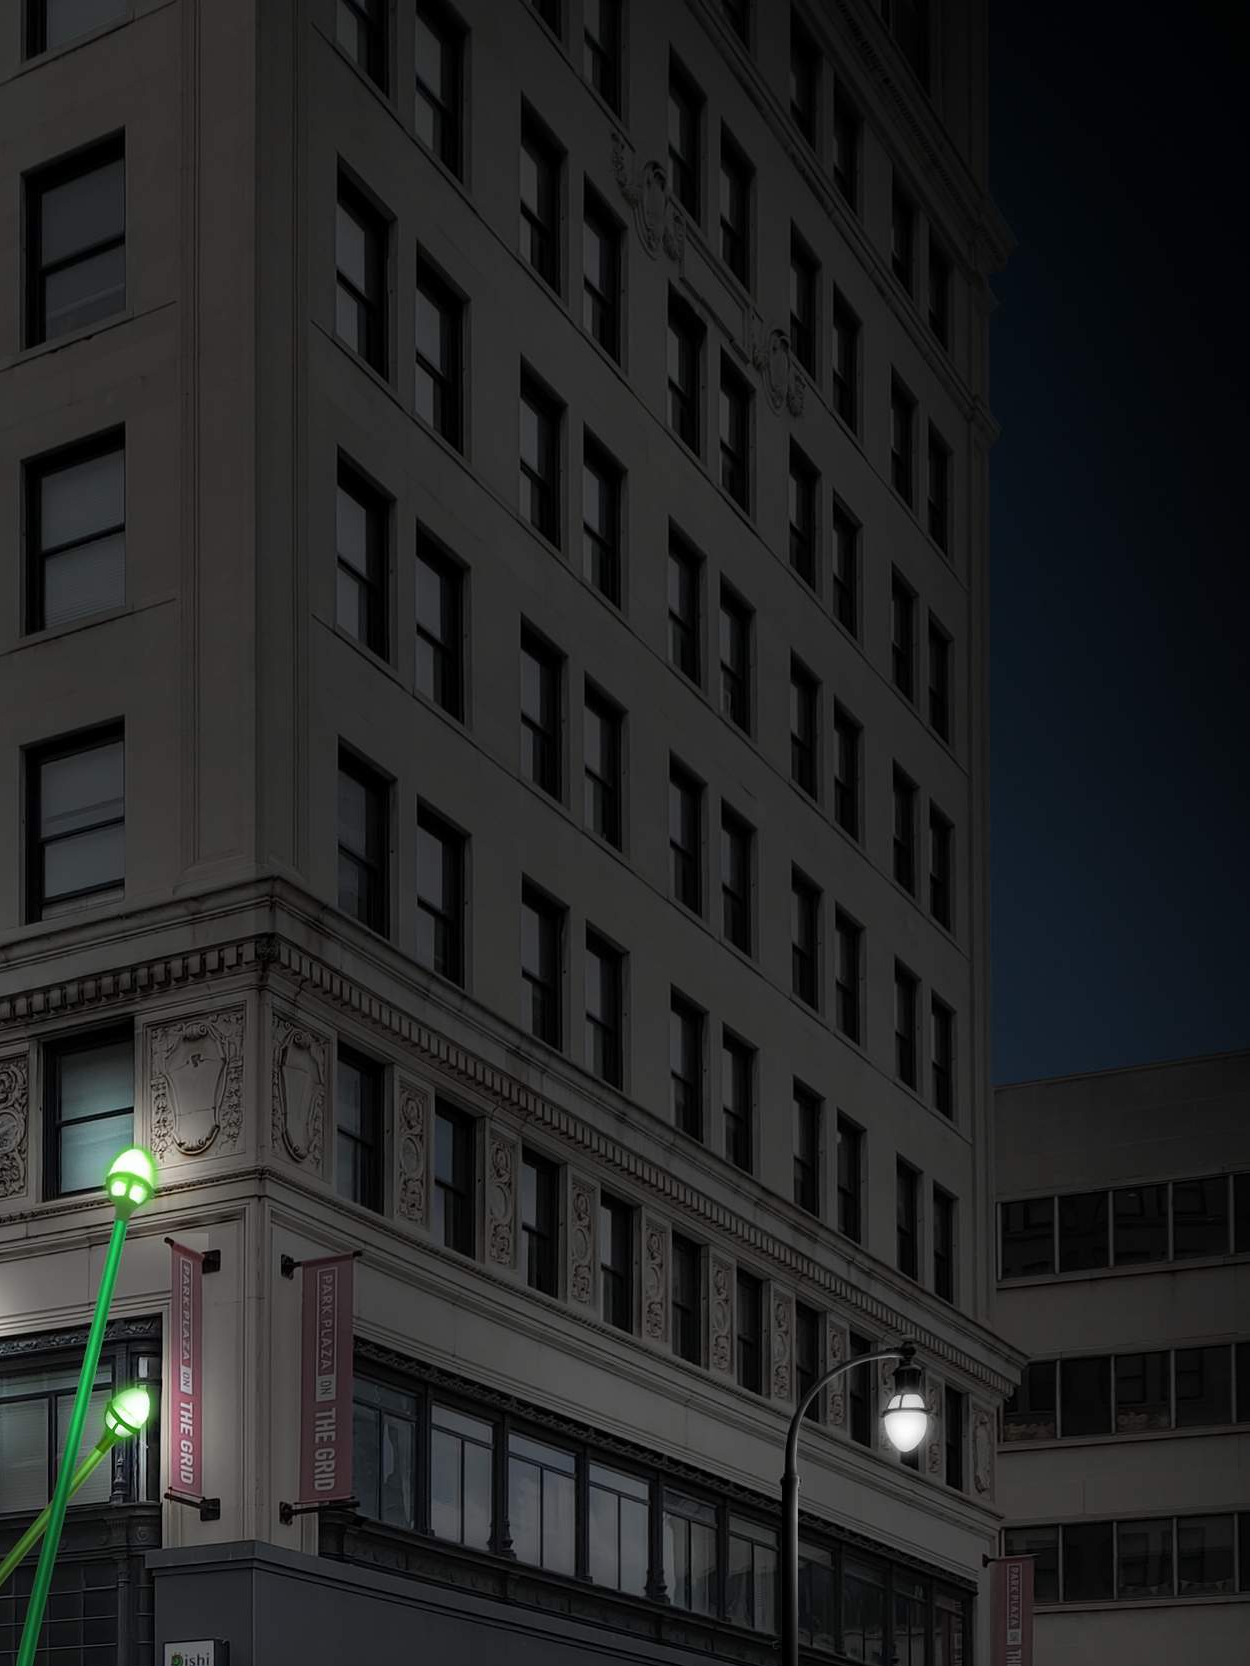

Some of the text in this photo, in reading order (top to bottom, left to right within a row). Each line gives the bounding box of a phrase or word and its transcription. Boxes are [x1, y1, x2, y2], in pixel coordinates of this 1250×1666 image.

[179, 1264, 194, 1486] PARK PLAZA ON THE GRID
[314, 1274, 336, 1492] PARK PLAZA ON THE GRID
[1010, 1567, 1019, 1592] PARK
[1010, 1595, 1019, 1626] PLAZA
